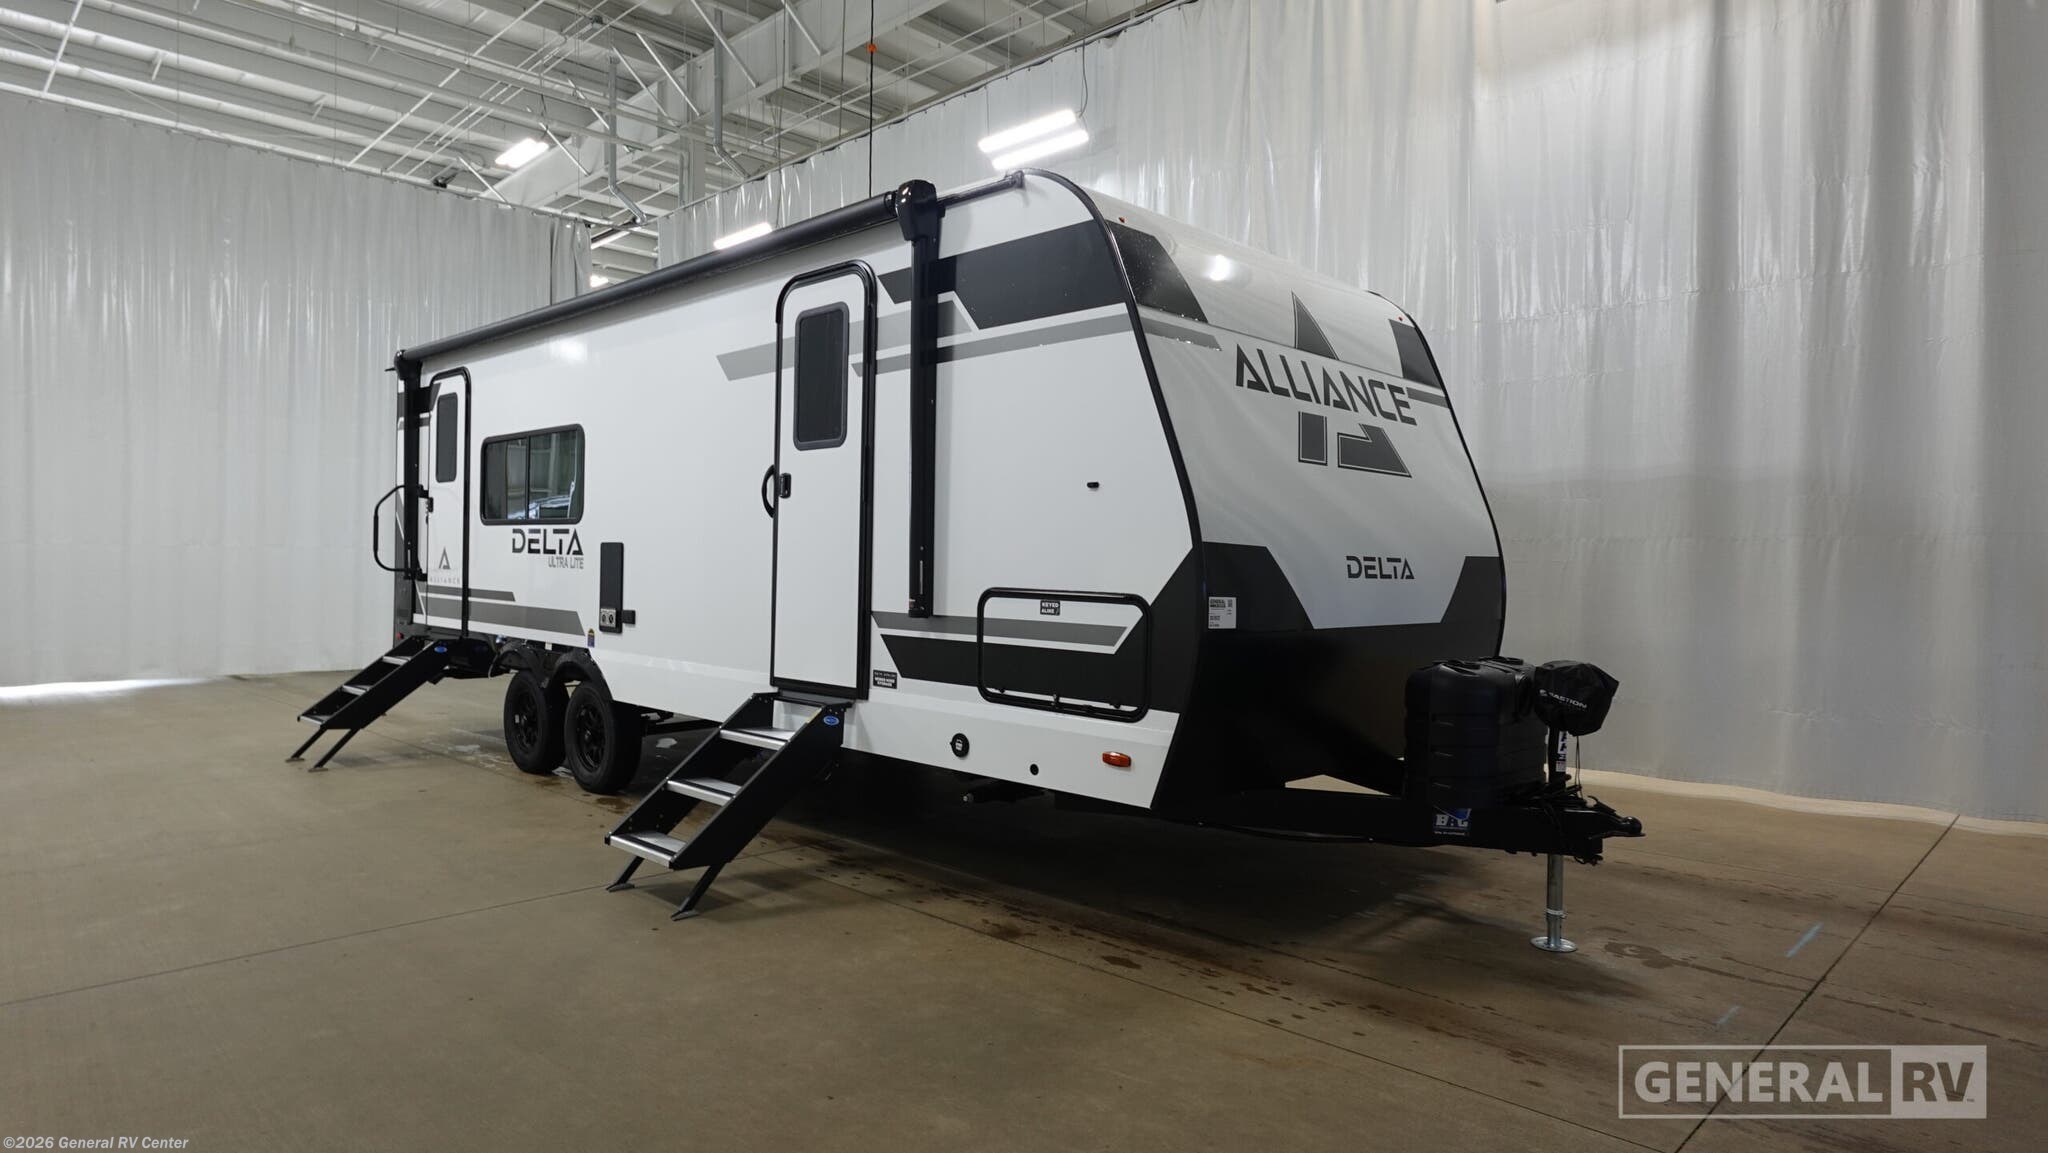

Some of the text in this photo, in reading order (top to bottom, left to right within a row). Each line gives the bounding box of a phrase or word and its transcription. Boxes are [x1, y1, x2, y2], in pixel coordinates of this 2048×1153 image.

[1235, 343, 1418, 426] ALLIANCE
[512, 528, 584, 556] DELTA
[547, 556, 584, 570] ULTRA LITE
[1346, 555, 1415, 580] DELTA
